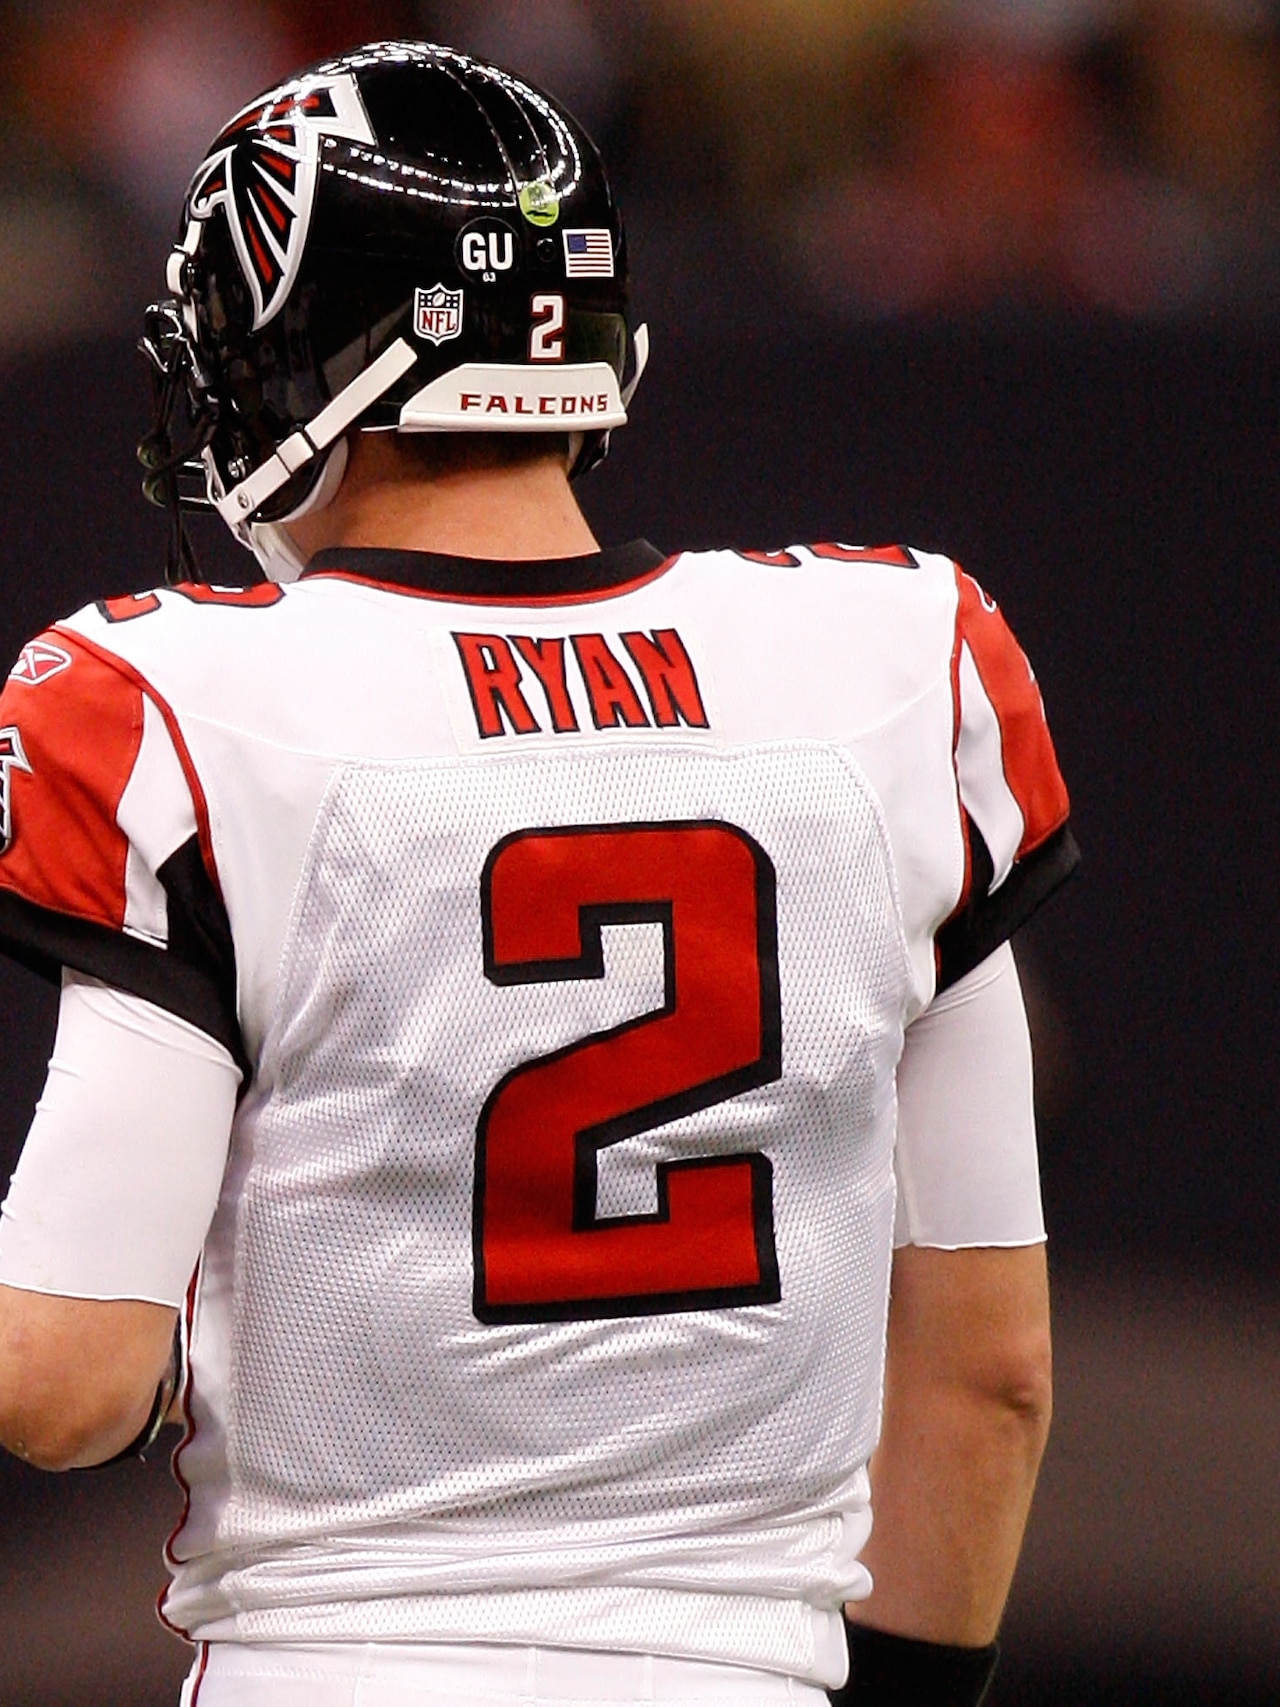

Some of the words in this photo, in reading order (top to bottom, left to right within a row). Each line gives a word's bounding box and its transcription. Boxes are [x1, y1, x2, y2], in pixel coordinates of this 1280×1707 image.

[462, 232, 513, 270] GU
[422, 309, 456, 333] NFL
[529, 292, 565, 362] 2
[460, 393, 608, 415] FALCONS
[451, 628, 710, 739] RYAN
[472, 818, 782, 1325] 2
